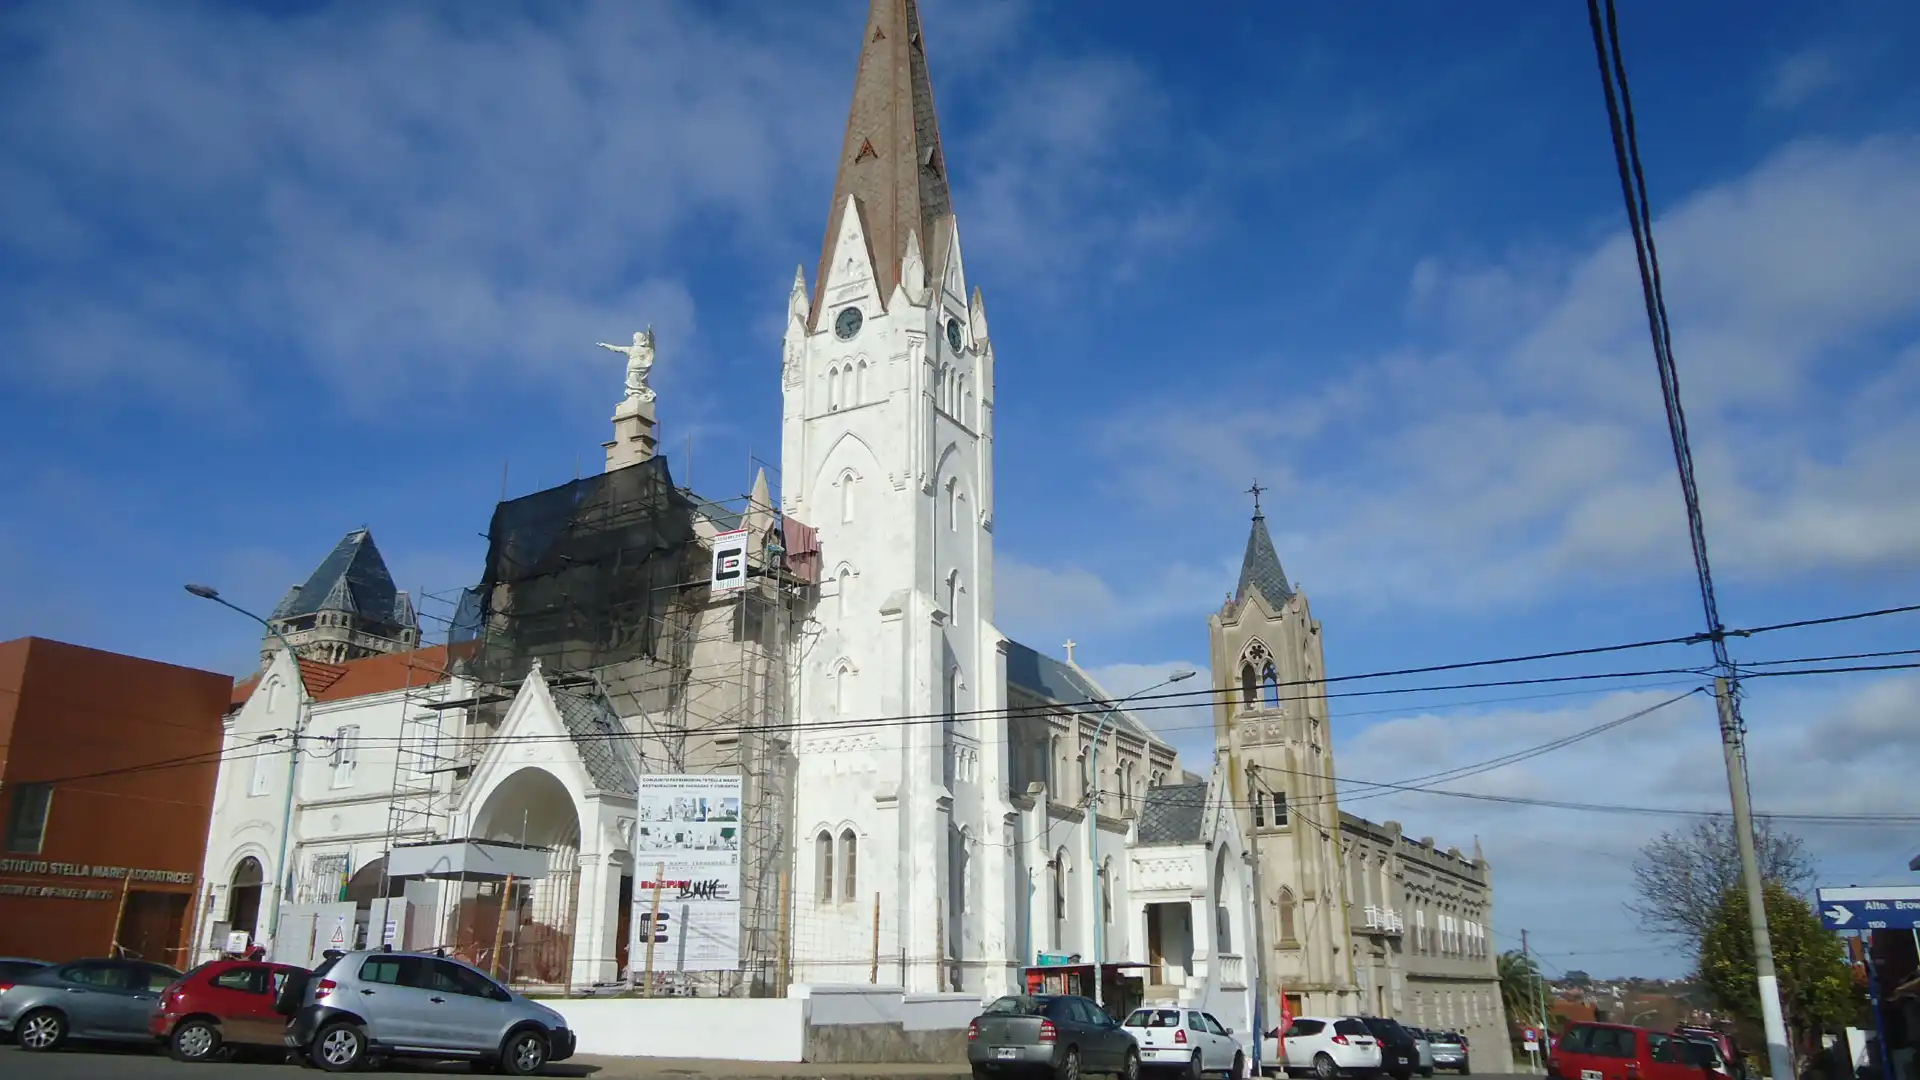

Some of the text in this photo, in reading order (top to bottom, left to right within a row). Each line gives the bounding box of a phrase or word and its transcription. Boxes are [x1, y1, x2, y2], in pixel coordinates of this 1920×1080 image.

[49, 862, 90, 877] STELLA
[92, 865, 126, 879] MARIS
[128, 868, 193, 884] ADORATRICES
